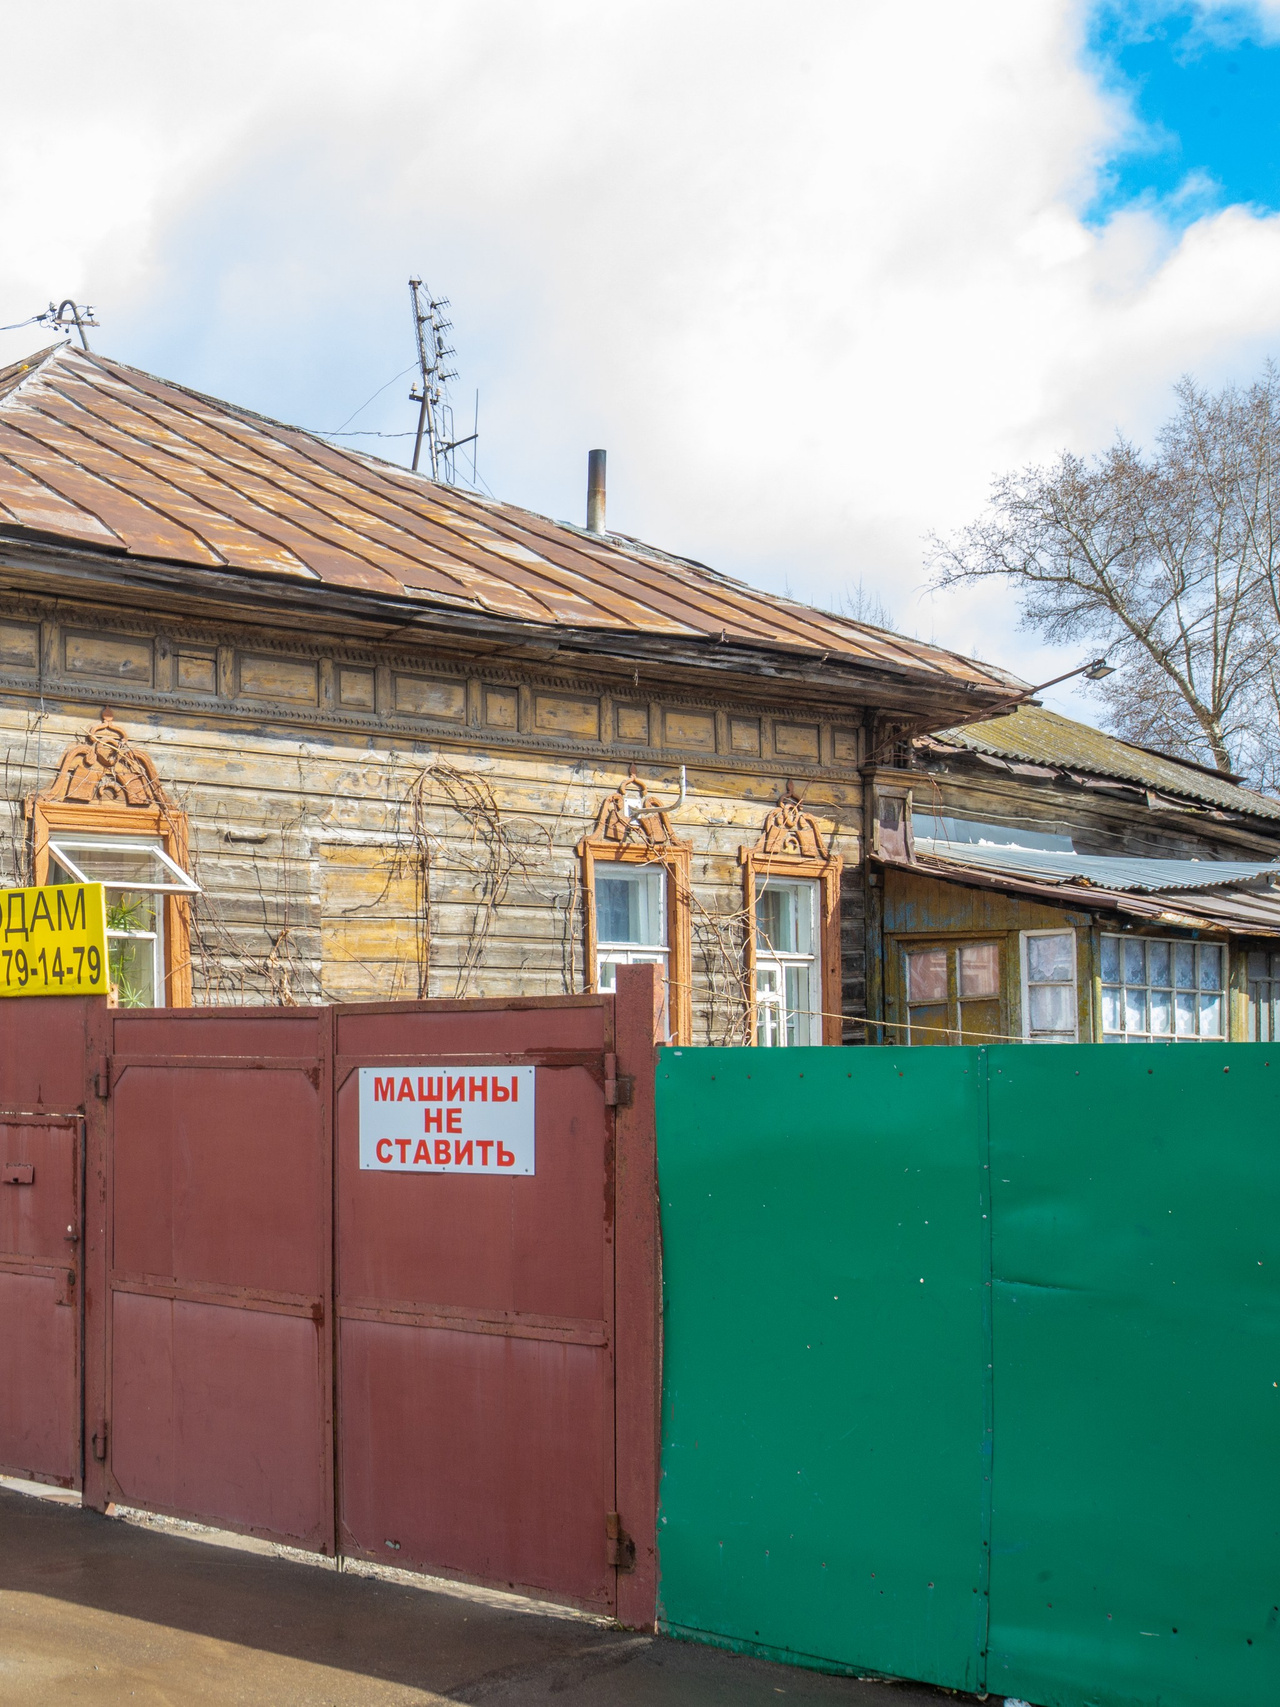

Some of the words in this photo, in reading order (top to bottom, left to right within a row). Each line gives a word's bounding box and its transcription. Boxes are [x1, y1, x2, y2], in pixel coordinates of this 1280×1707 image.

[374, 1076, 518, 1103] МАШИНЫ
[424, 1108, 463, 1134] НЕ
[375, 1138, 516, 1167] СТАВИТЬ
